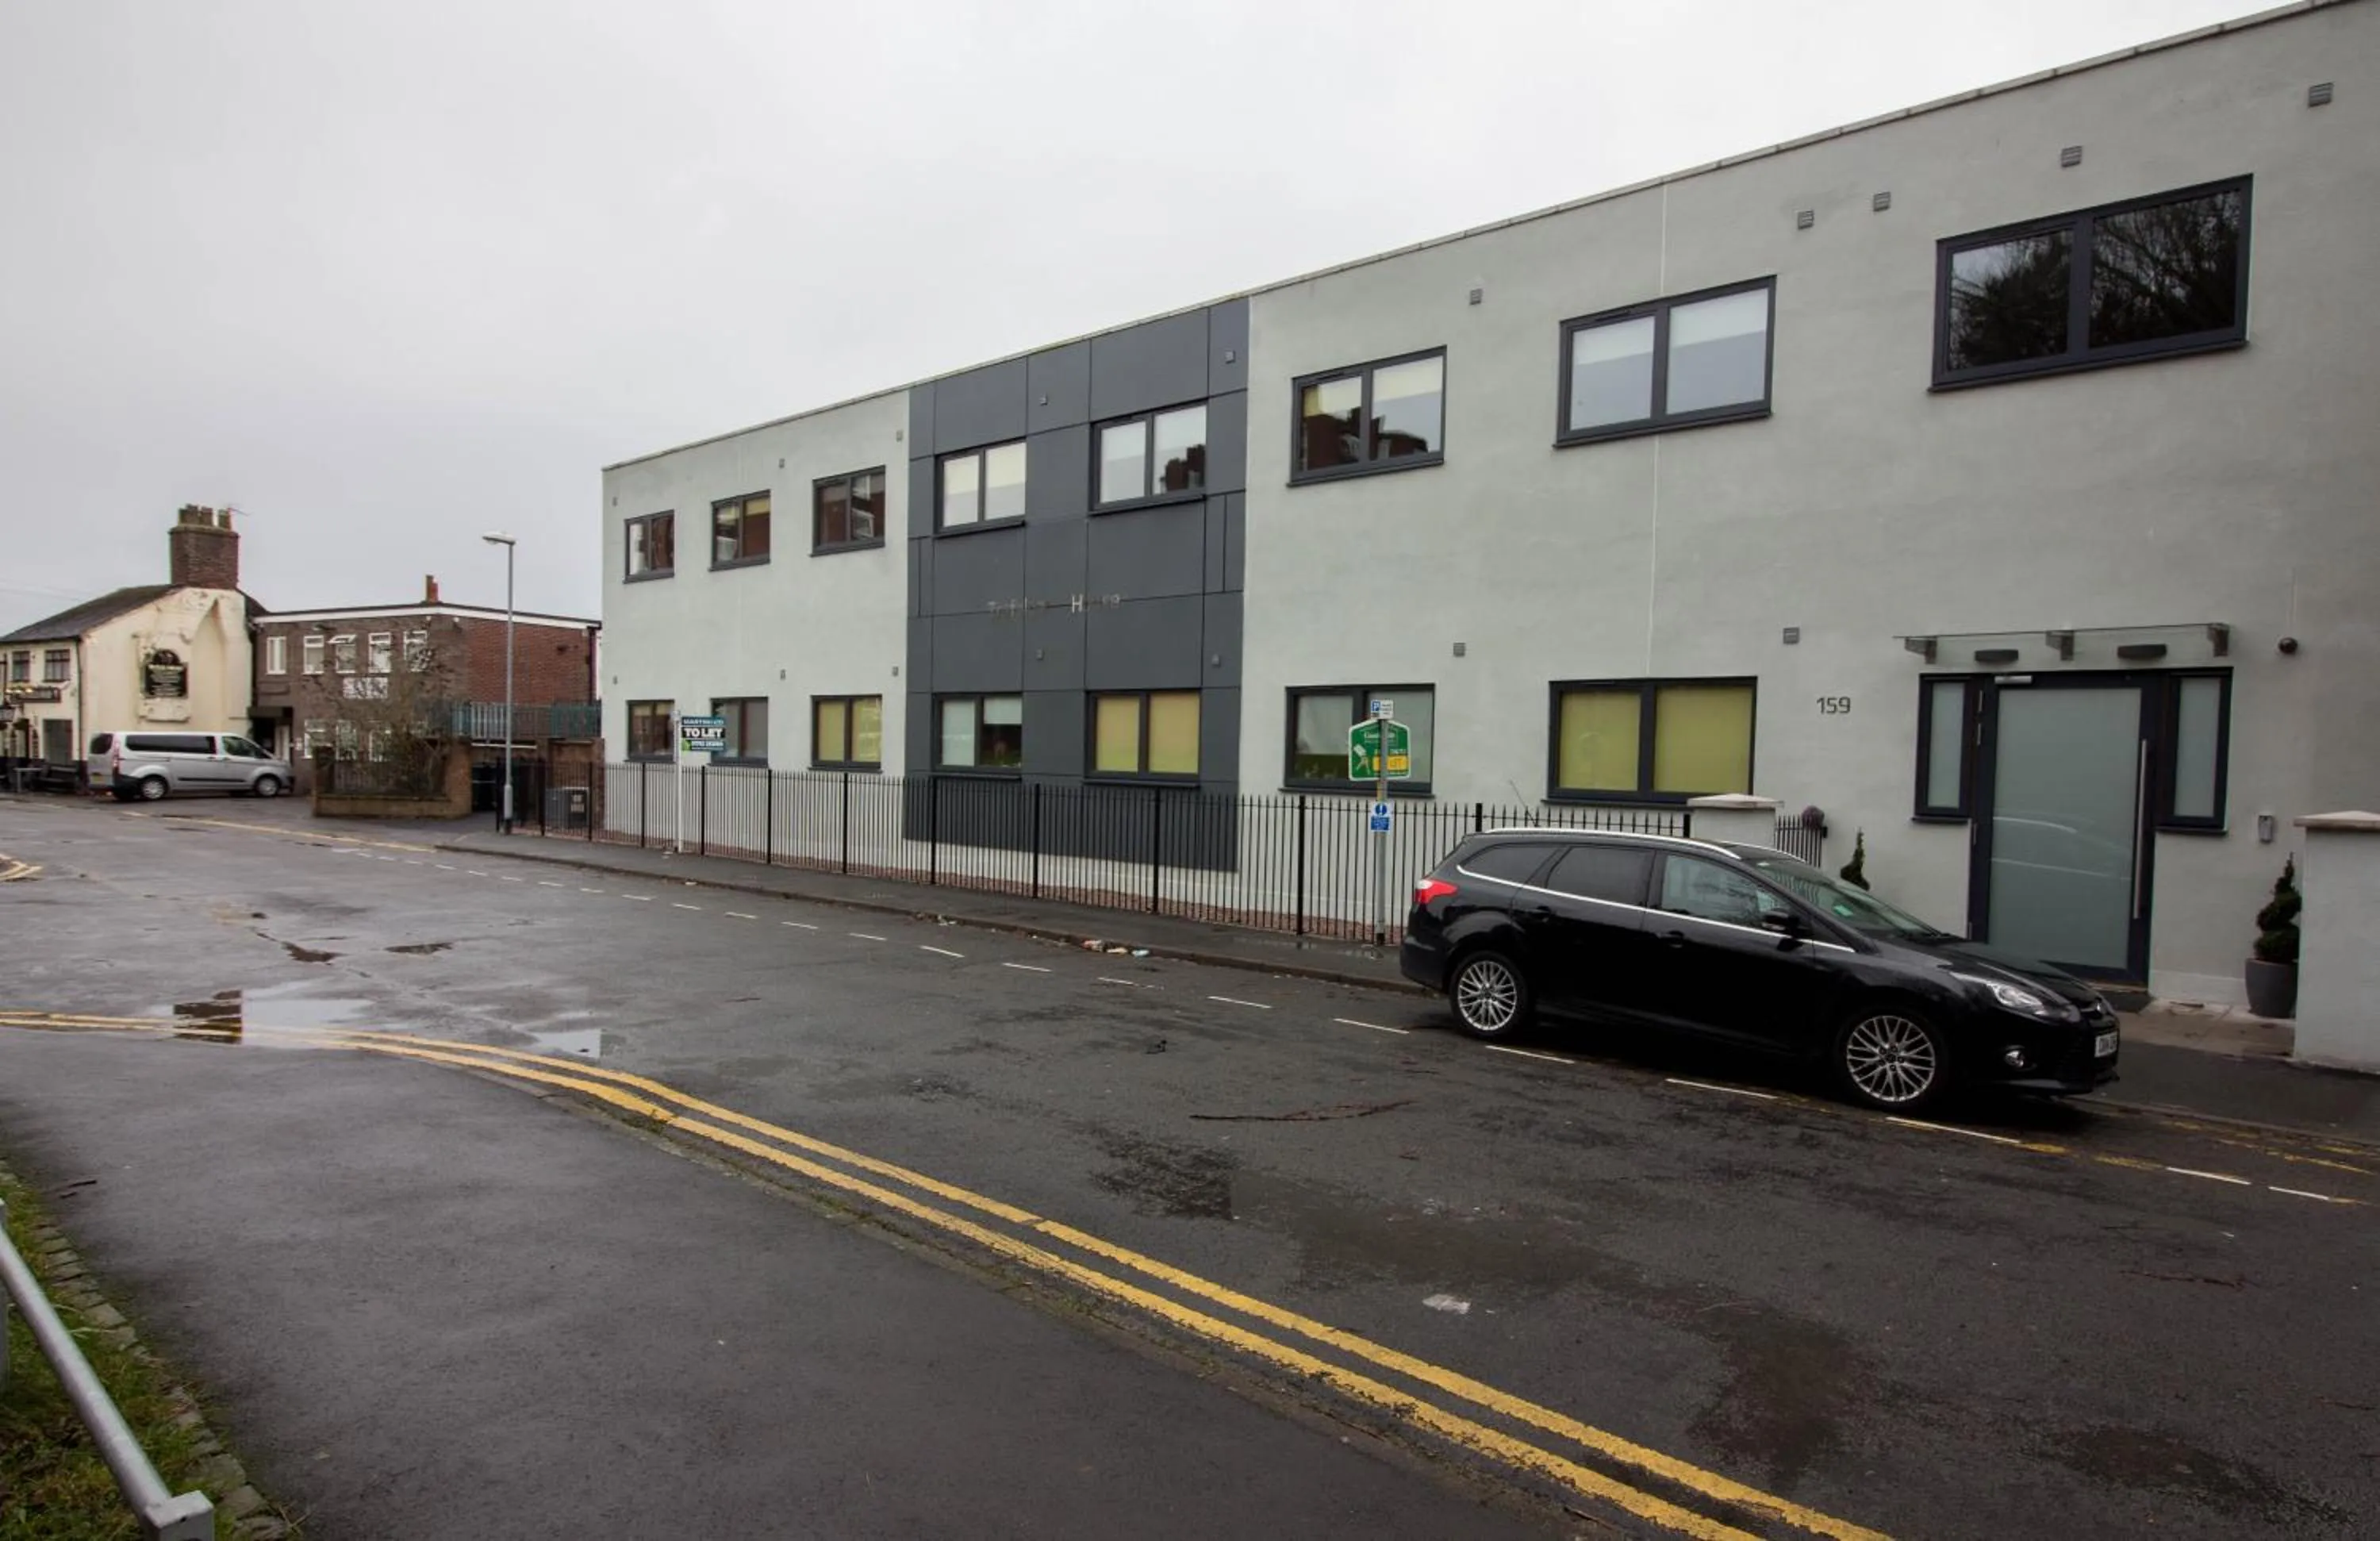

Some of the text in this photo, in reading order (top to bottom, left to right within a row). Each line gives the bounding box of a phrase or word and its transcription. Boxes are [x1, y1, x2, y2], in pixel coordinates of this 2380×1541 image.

[1817, 697, 1850, 713] 159
[684, 728, 723, 737] TO LET
